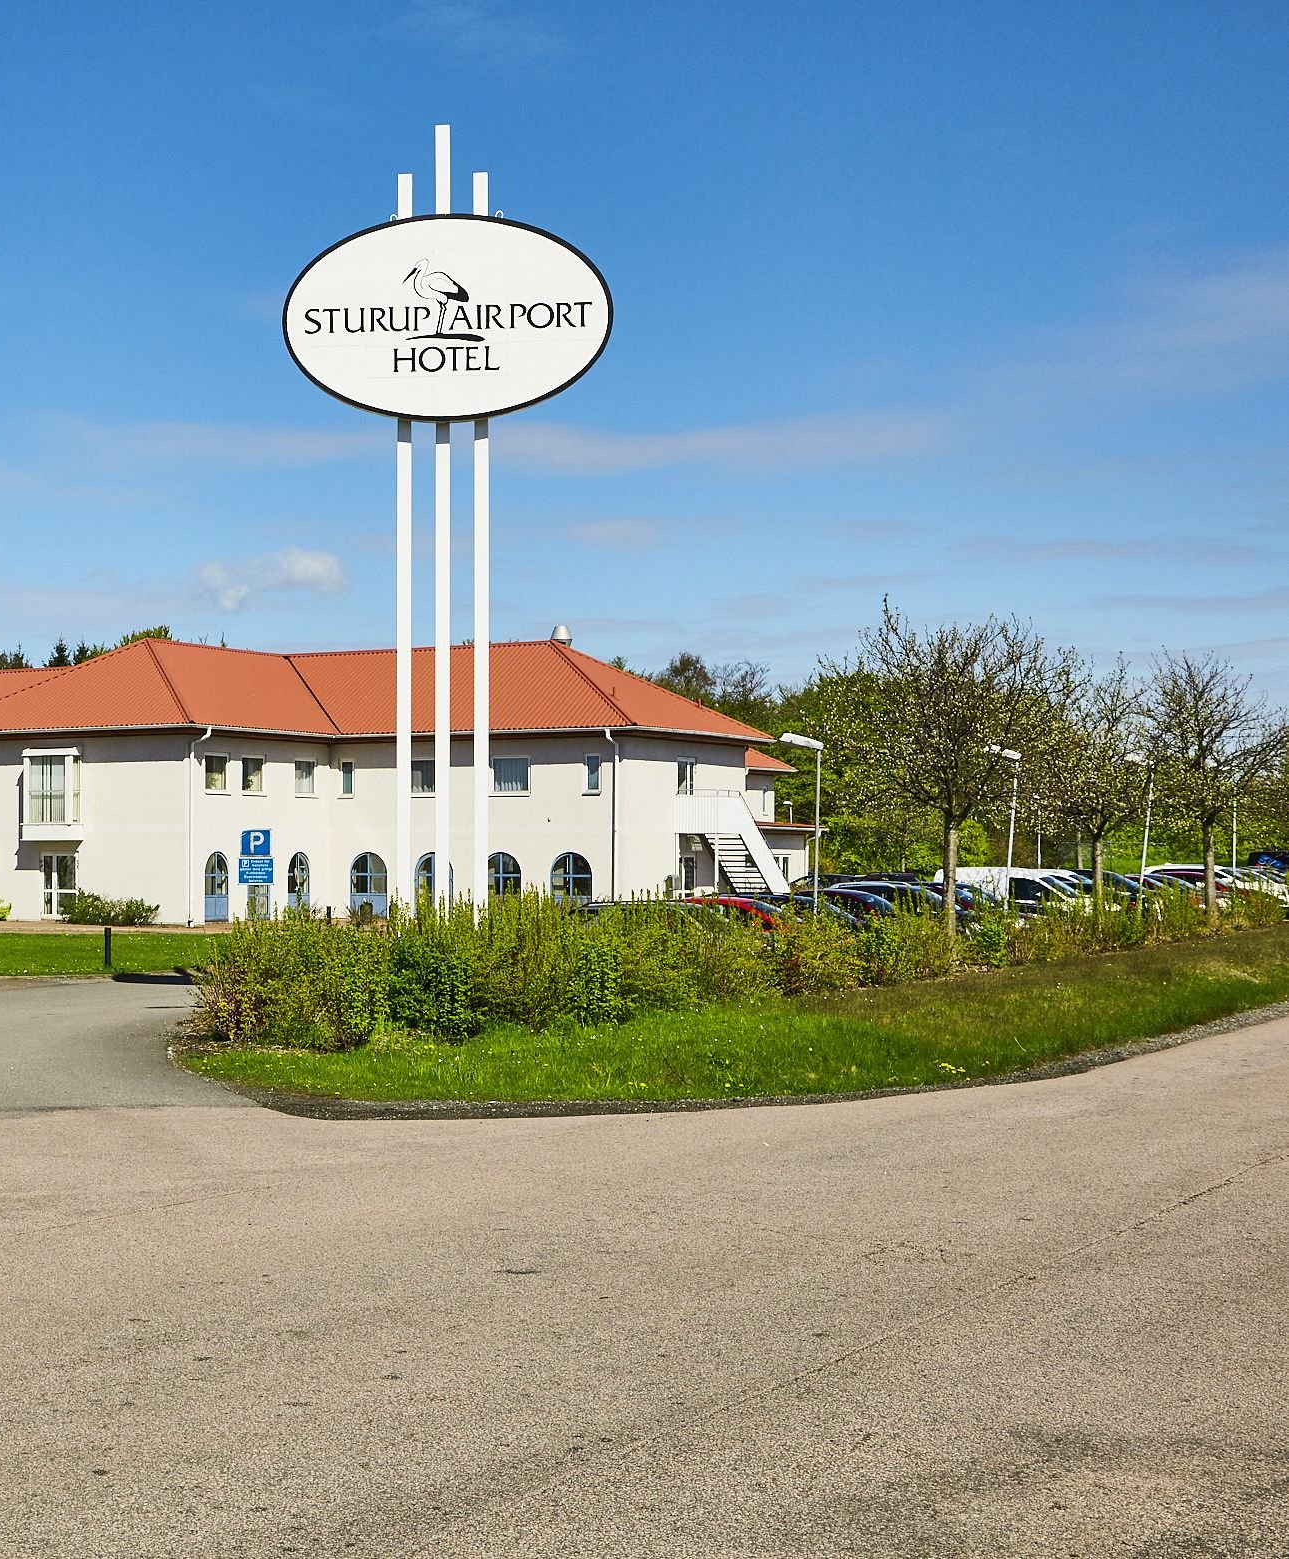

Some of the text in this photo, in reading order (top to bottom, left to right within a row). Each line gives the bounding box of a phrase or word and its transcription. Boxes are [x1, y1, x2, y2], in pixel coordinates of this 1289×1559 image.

[304, 301, 593, 334] STURUP AIRPORT
[393, 345, 500, 373] HOTEL
[250, 832, 264, 853] P
